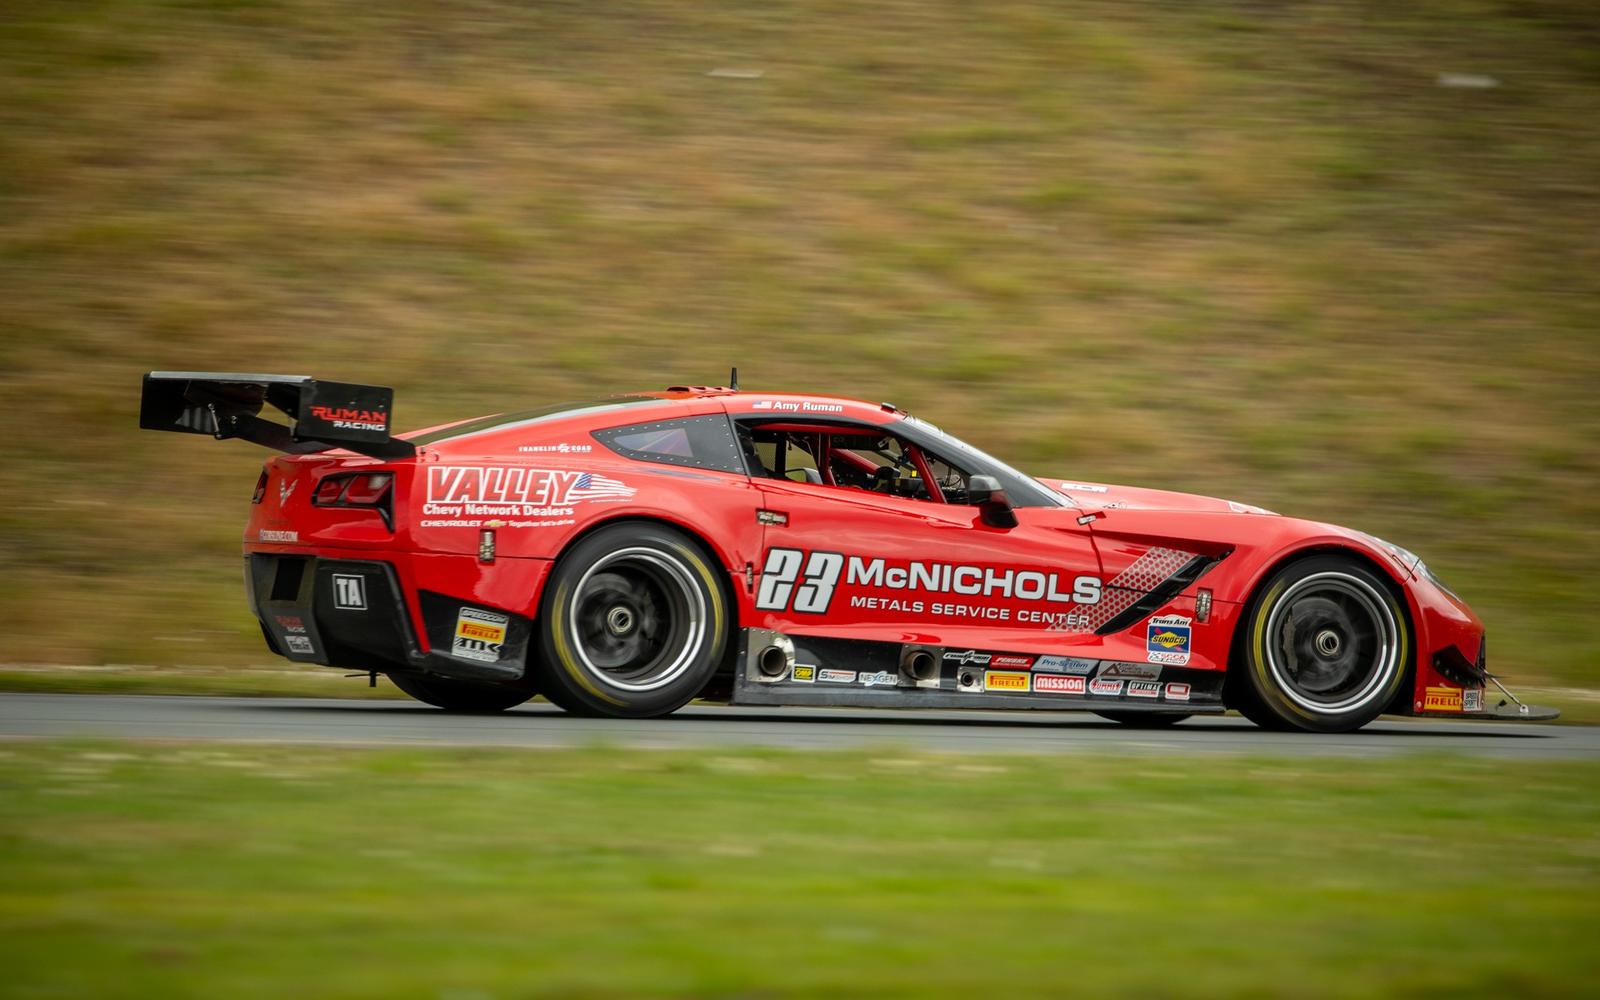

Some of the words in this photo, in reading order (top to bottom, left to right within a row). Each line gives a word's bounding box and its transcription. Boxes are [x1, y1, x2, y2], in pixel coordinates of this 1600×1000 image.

[774, 401, 800, 412] Amy
[803, 402, 843, 412] Ruman
[309, 406, 386, 424] RUMAN
[333, 421, 386, 431] RACING
[427, 466, 579, 505] VALLEY
[422, 504, 463, 517] Chevy
[465, 505, 520, 516] Network
[523, 506, 574, 516] Dealers
[755, 547, 844, 614] 23
[847, 556, 1102, 605] McNICHOLS
[336, 579, 362, 606] TA
[851, 596, 924, 613] METALS
[931, 603, 1010, 620] SERVICE
[1017, 610, 1090, 626] CENTER
[1152, 635, 1186, 645] SUNOCO
[860, 672, 898, 685] NEXGEN
[990, 675, 1026, 687] PIRELLI
